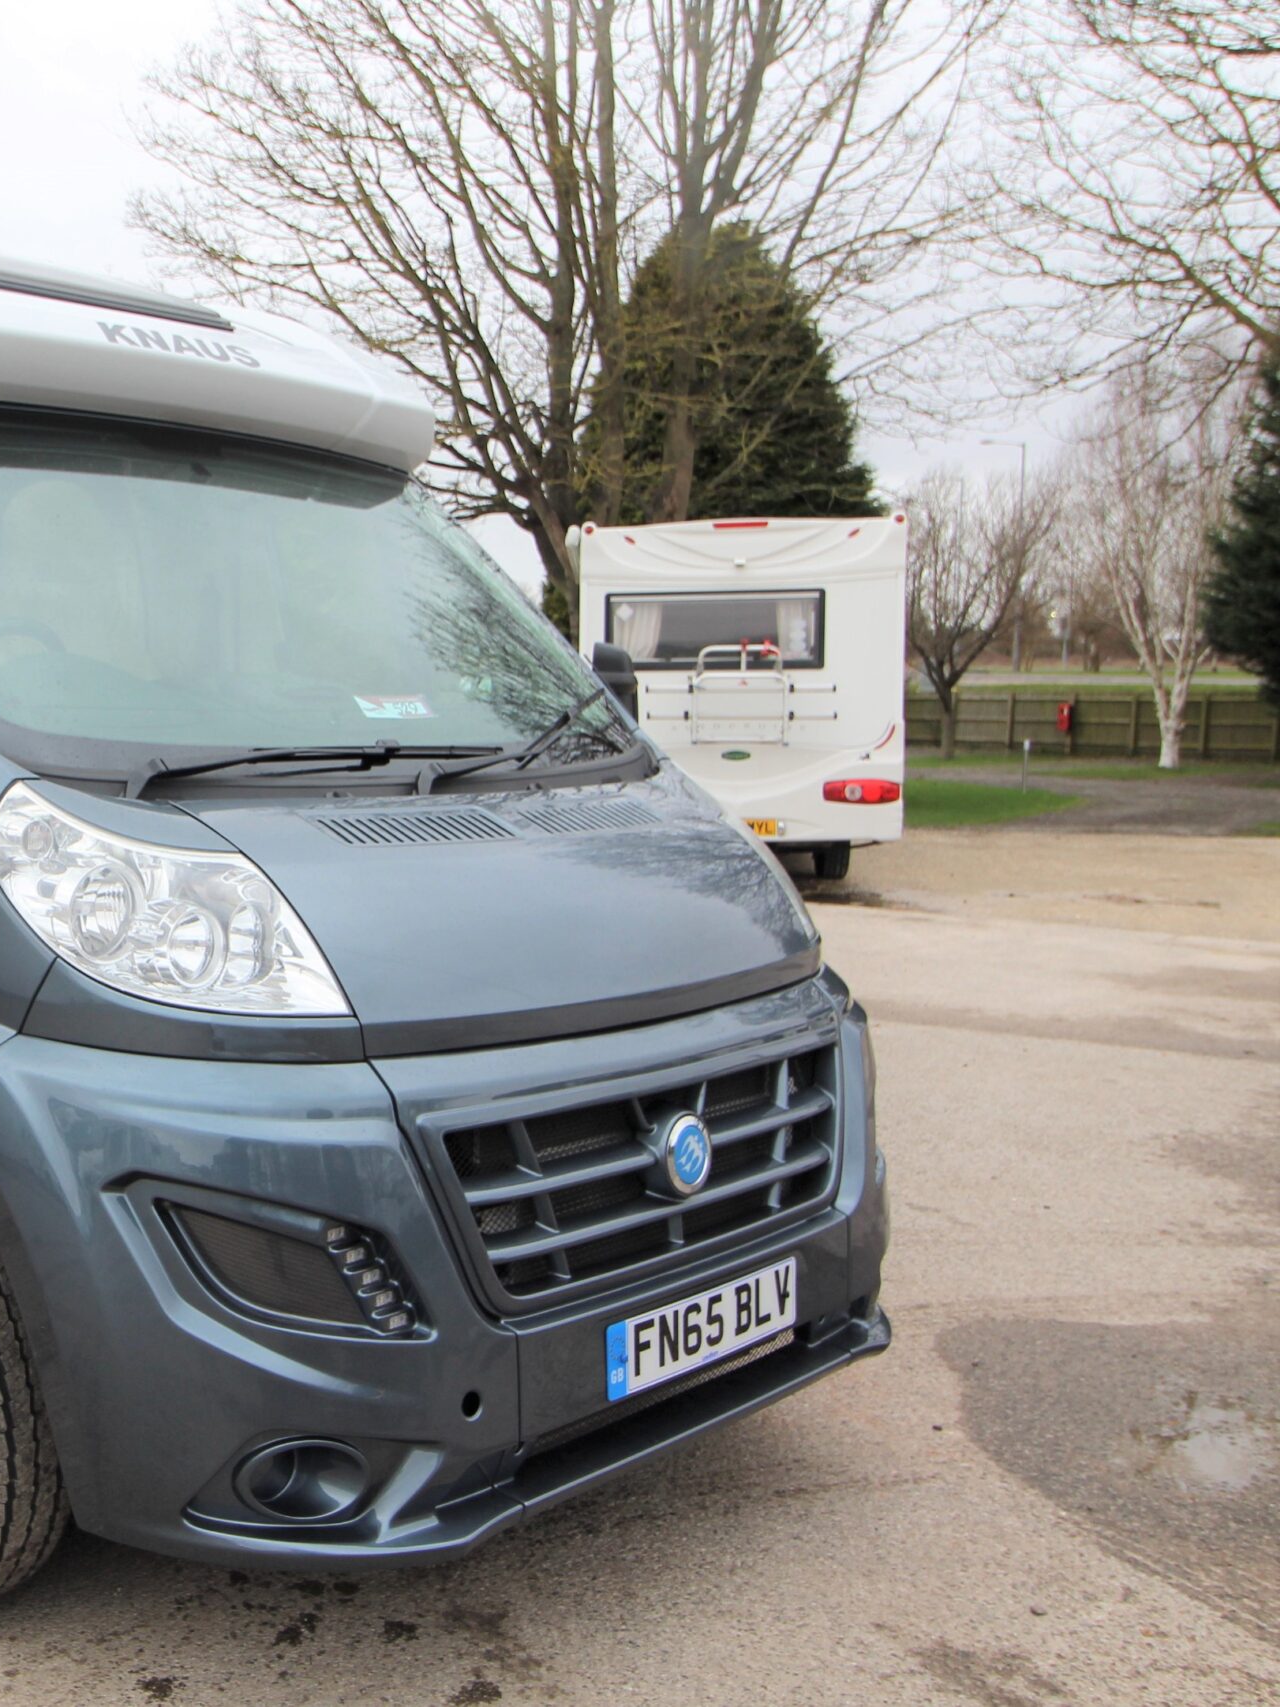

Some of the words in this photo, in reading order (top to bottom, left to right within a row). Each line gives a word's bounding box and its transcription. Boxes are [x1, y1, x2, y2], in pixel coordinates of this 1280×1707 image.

[96, 321, 261, 368] KNAUS
[633, 1293, 724, 1377] FN65
[734, 1265, 790, 1336] BLV
[610, 1368, 624, 1385] GB
